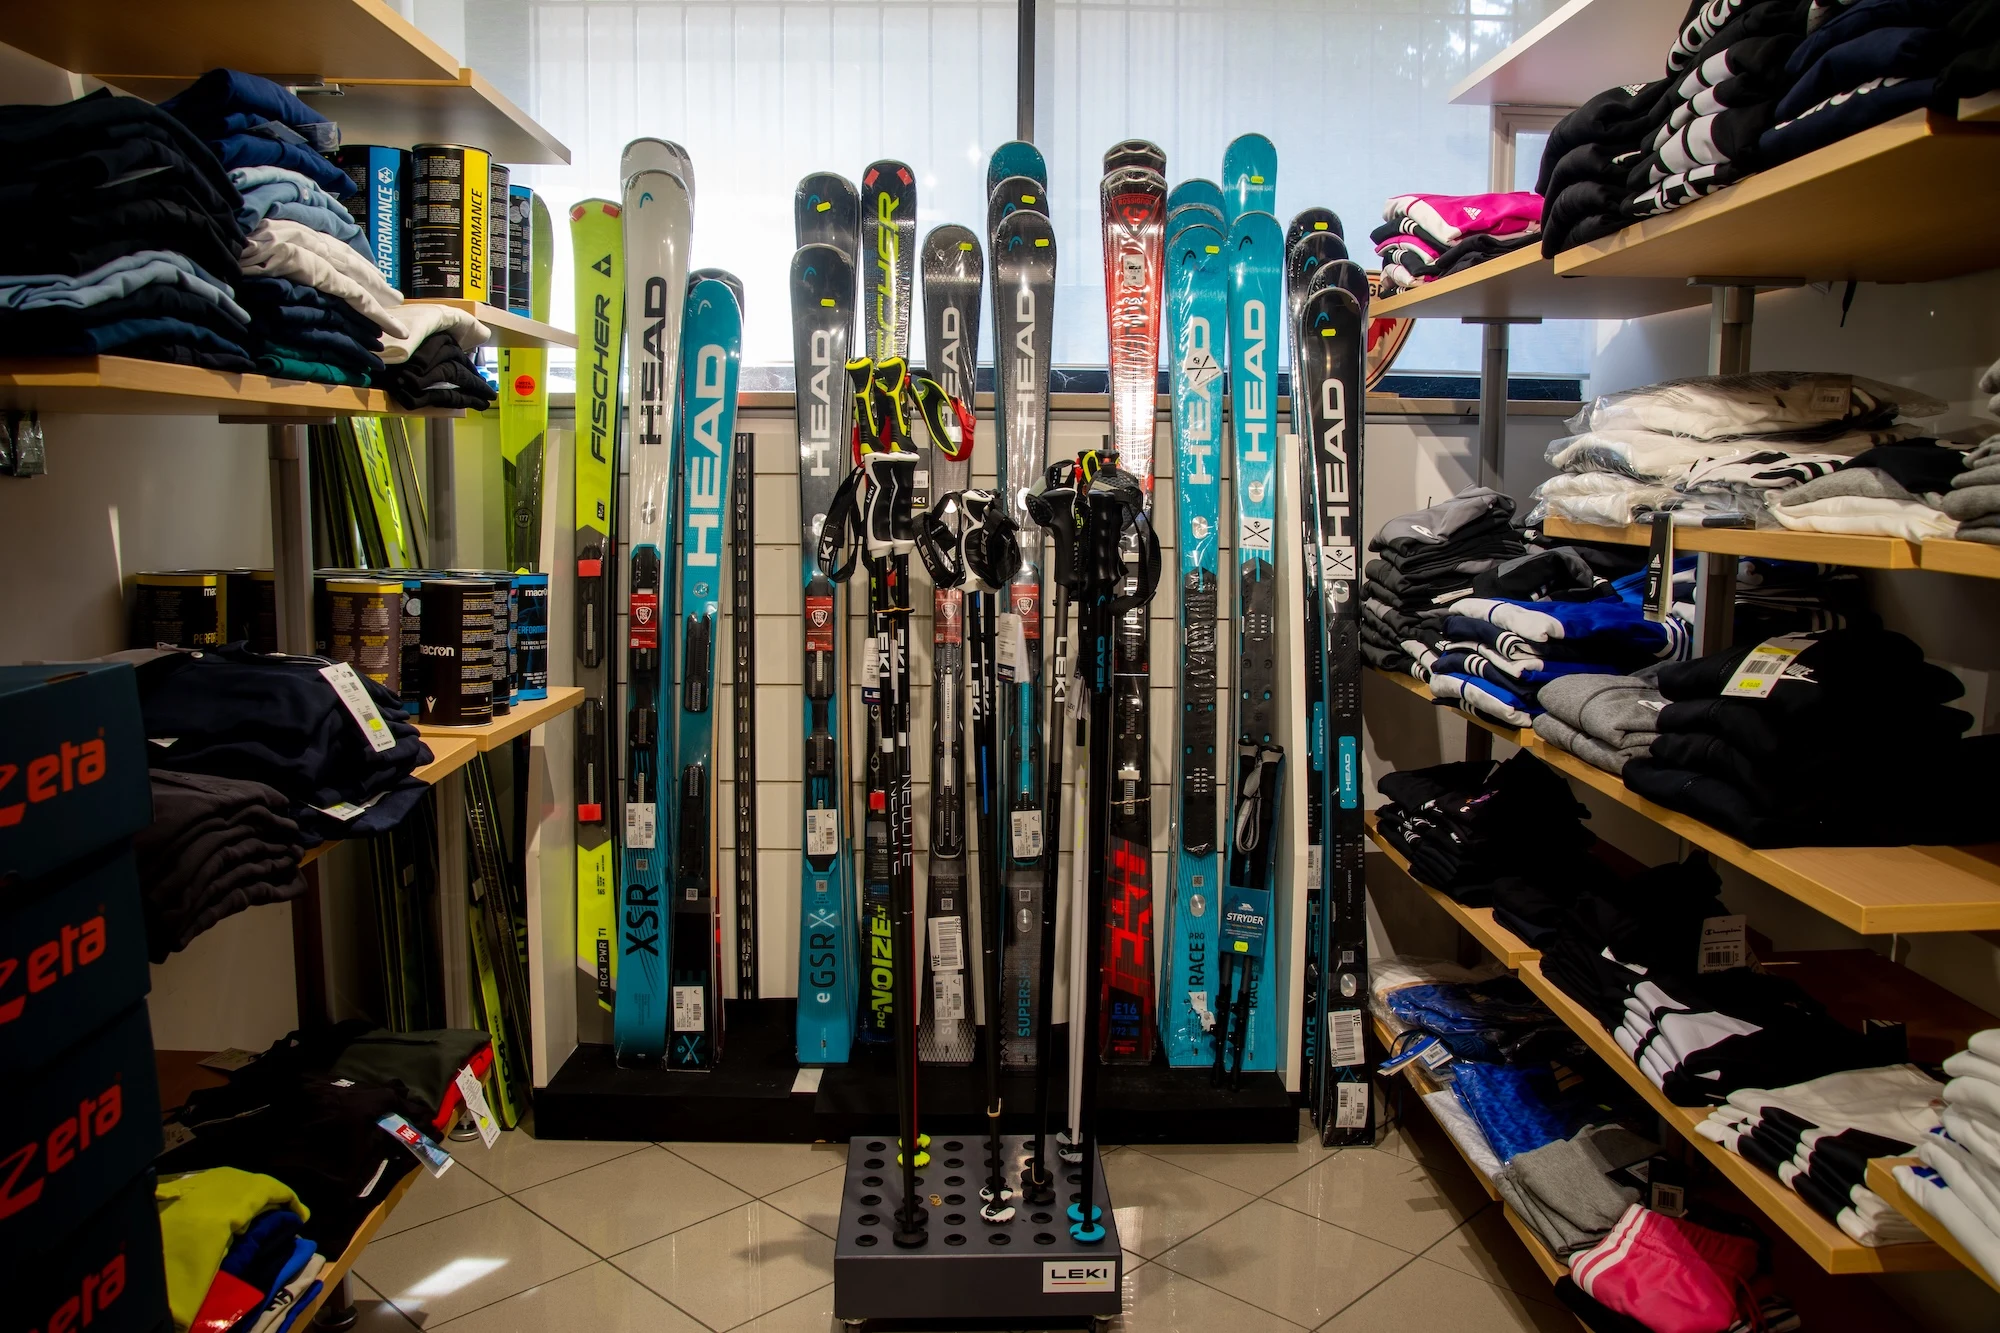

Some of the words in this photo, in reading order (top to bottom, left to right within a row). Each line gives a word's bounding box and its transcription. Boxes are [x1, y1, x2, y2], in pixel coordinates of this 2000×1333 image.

[470, 188, 482, 289] PERFORMANCE
[877, 191, 899, 358] SCHER
[591, 293, 612, 464] FISCHER
[639, 276, 669, 445] HEAD
[1016, 290, 1036, 426] HEAD
[1243, 299, 1267, 462] HEAD
[810, 329, 830, 478] HEAD
[687, 343, 727, 567] HEAD
[1321, 378, 1351, 546] HEAD
[203, 587, 218, 597] mac
[877, 612, 890, 678] LEKI
[1054, 637, 1067, 702] LEKI
[1095, 634, 1106, 694] HEAD
[598, 928, 607, 937] TI
[626, 884, 659, 957] XSR
[877, 905, 886, 920] LT
[1226, 912, 1265, 926] STRYDER
[598, 942, 608, 963] PWR
[599, 967, 608, 988] RC4
[810, 933, 836, 988] GSR
[871, 917, 893, 1014] NOIZE
[932, 954, 940, 967] WE
[1188, 943, 1204, 986] RACE
[1113, 1002, 1137, 1014] E16
[1249, 972, 1258, 1009] RACE
[1352, 1013, 1361, 1026] WE
[0, 1083, 123, 1220] Zeta
[27, 1252, 126, 1333] eta
[1051, 1268, 1107, 1279] LEKI
